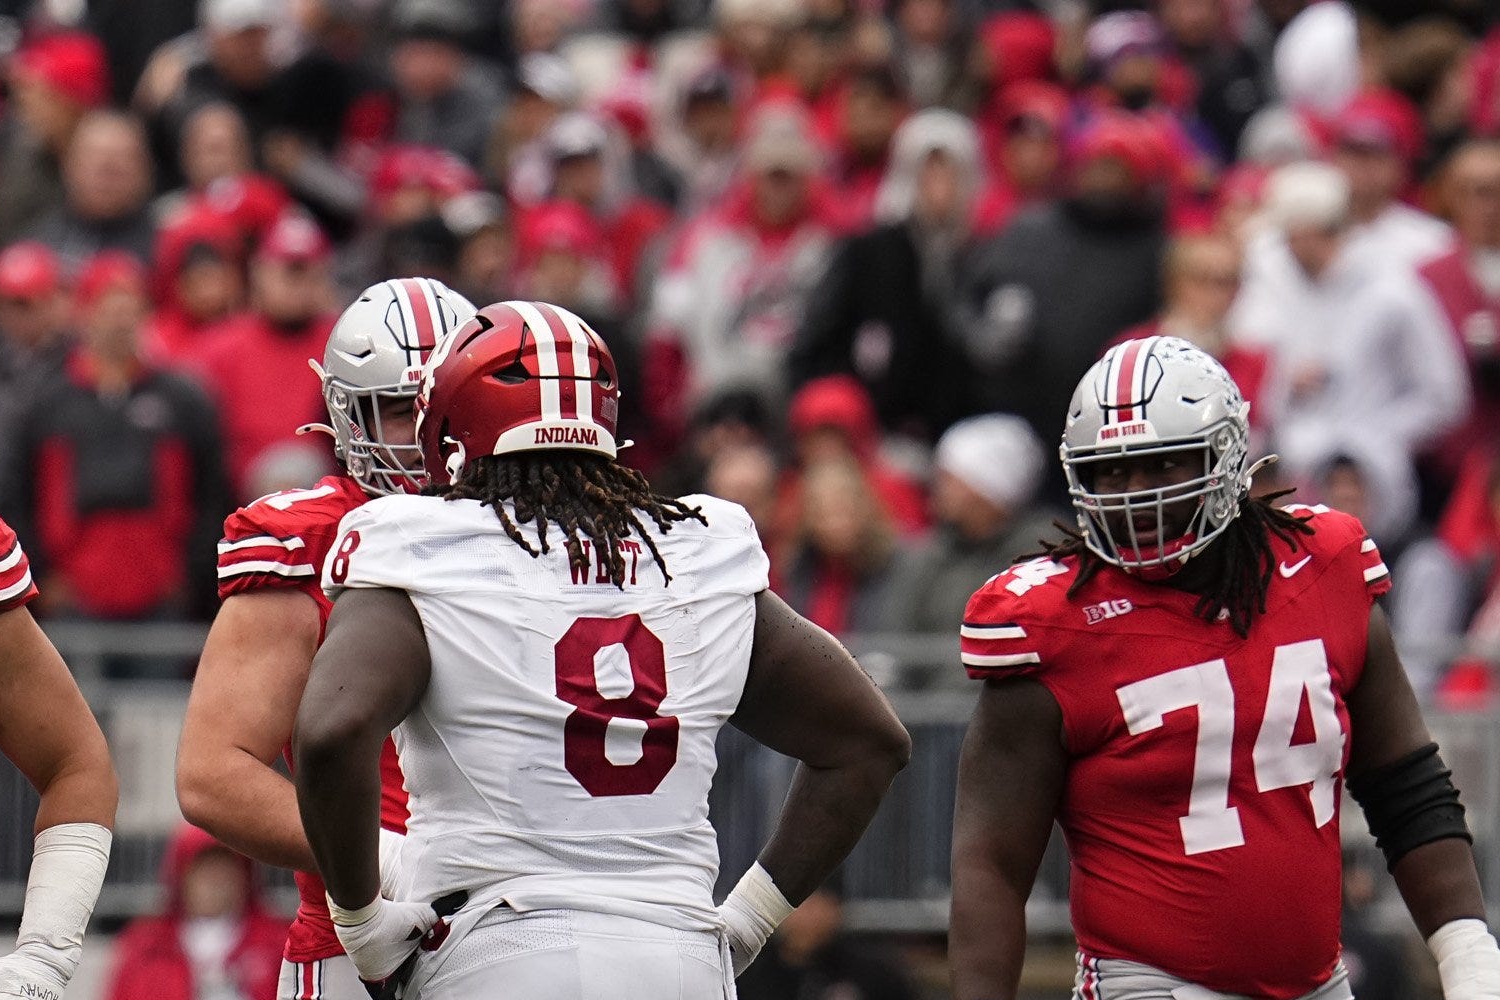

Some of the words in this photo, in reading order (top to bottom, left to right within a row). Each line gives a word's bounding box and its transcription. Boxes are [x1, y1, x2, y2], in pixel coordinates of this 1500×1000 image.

[407, 369, 422, 382] OH
[534, 427, 599, 446] INDIANA
[330, 529, 361, 585] 8
[554, 612, 681, 798] 8
[1116, 638, 1346, 856] 74
